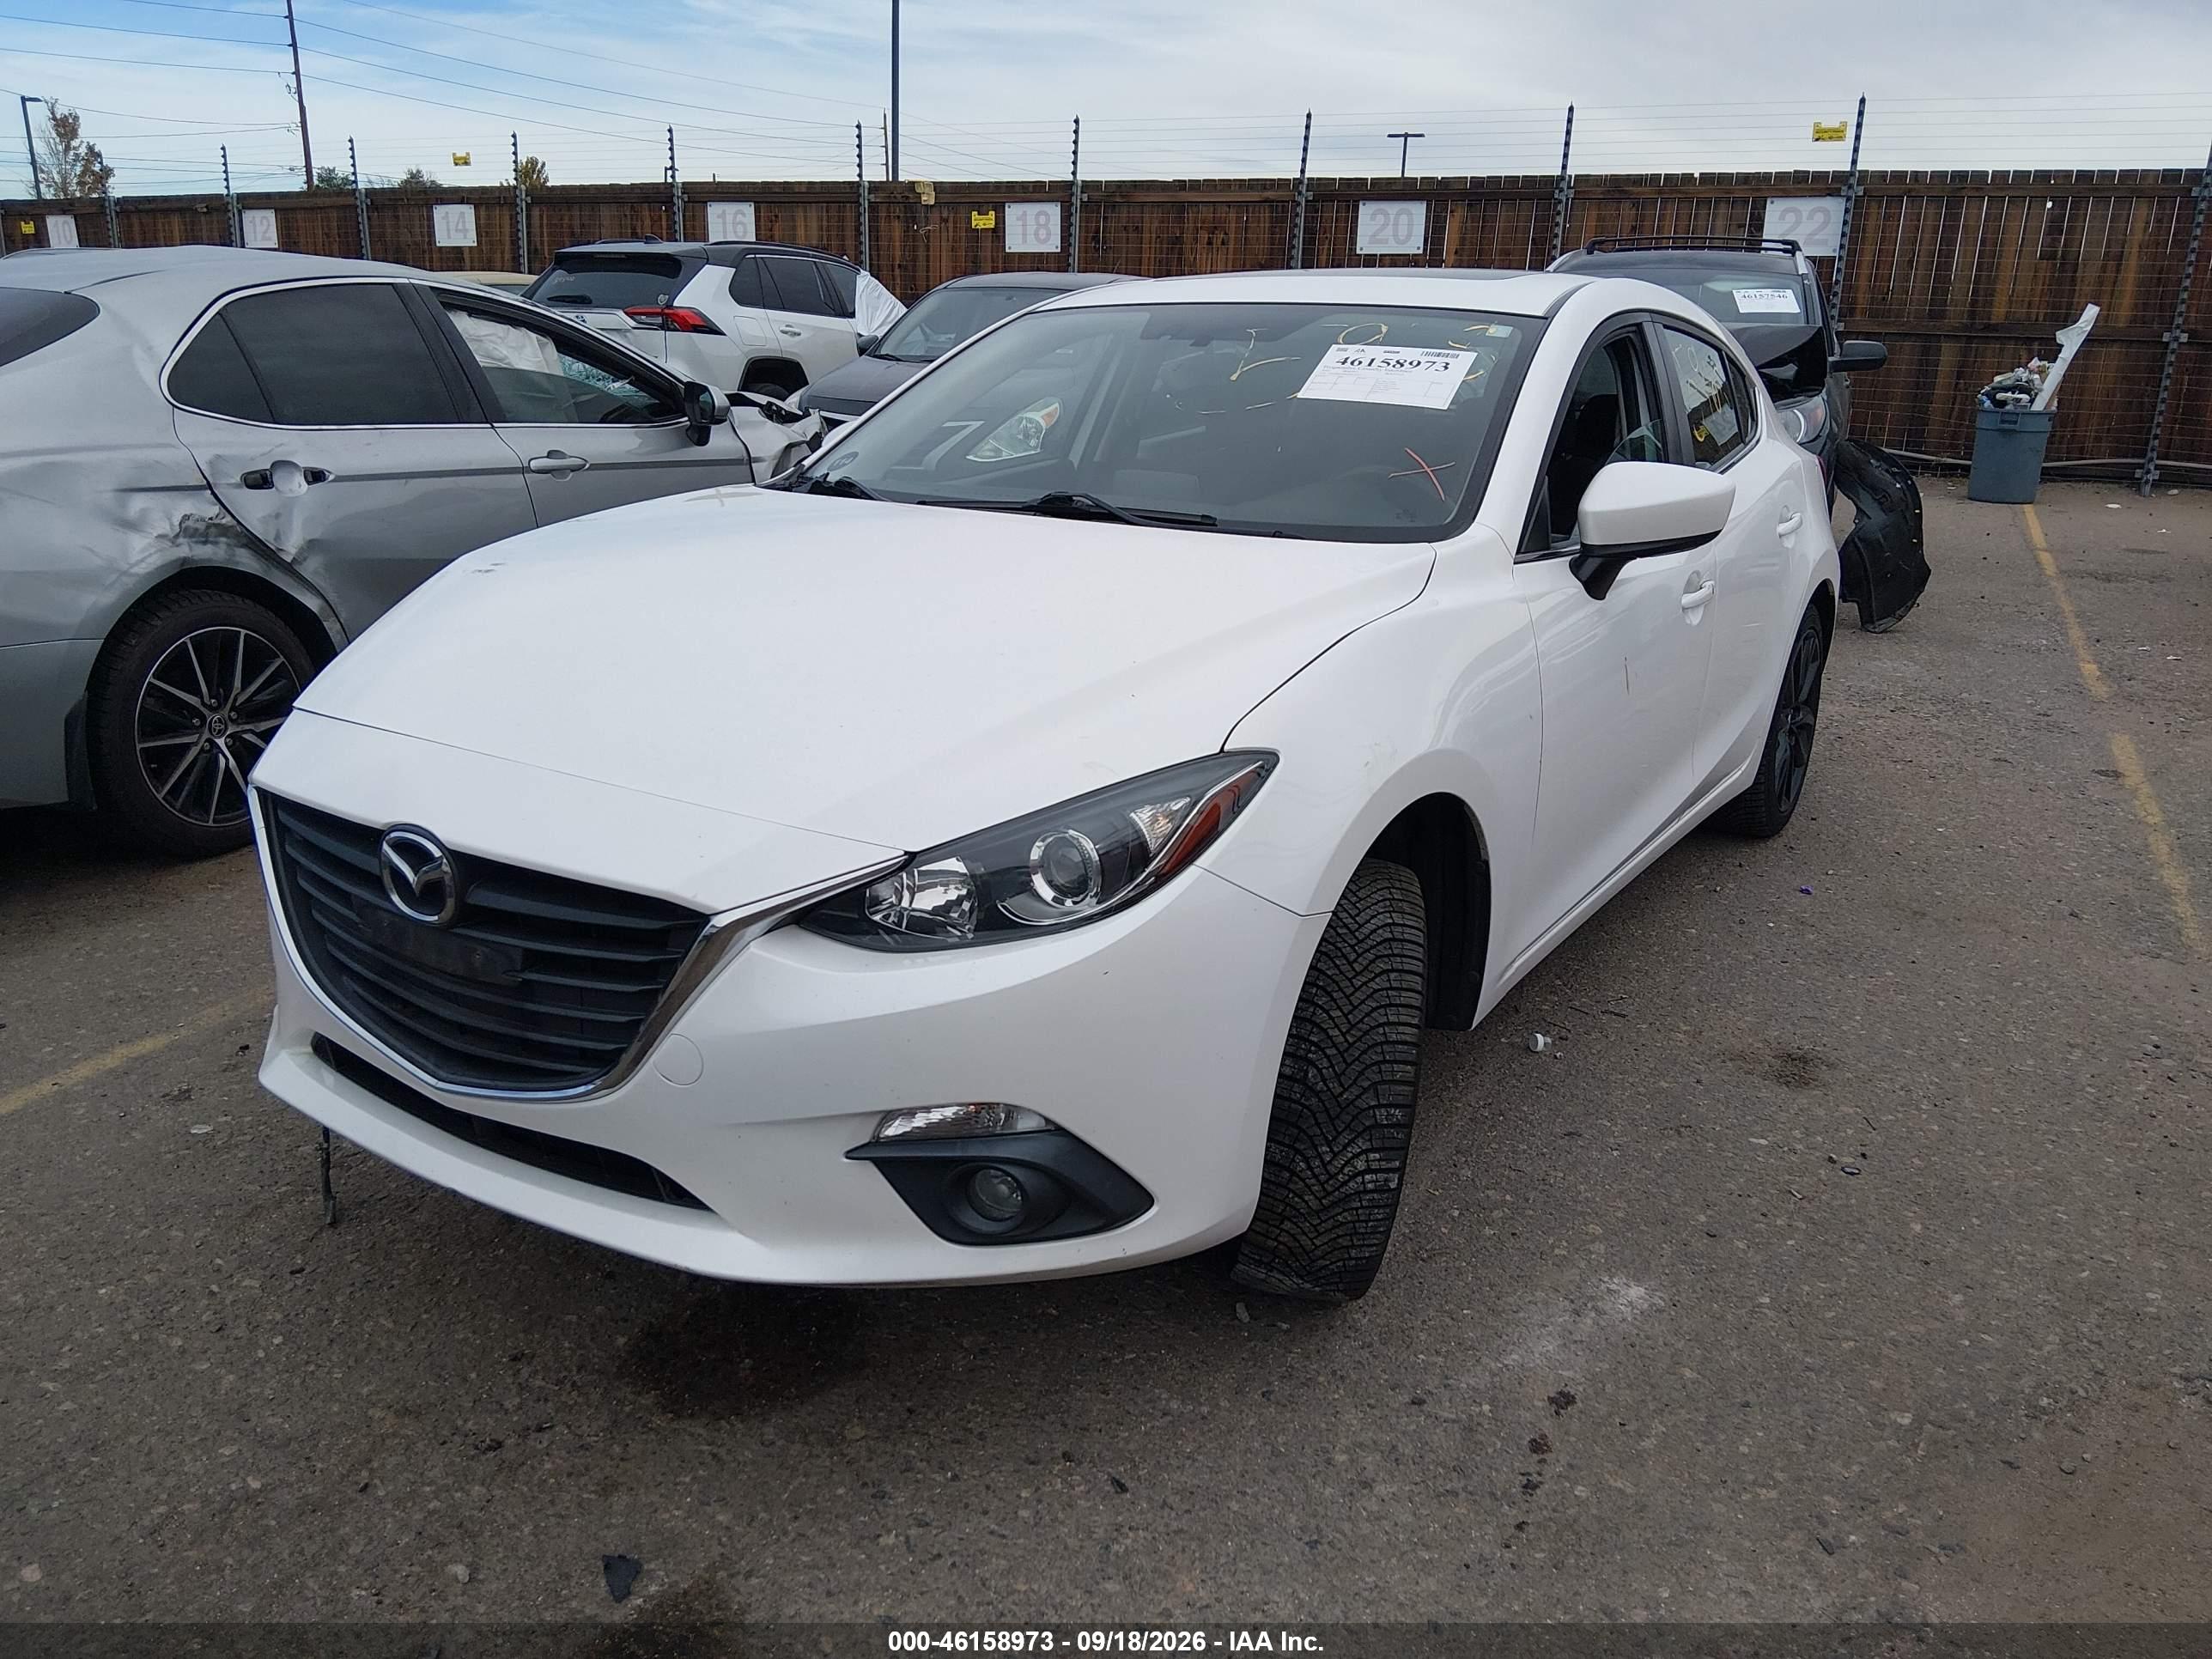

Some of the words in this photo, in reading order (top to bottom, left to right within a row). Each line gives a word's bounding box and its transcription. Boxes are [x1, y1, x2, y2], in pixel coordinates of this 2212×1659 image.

[249, 215, 272, 241] 12
[441, 210, 469, 240] 14
[716, 209, 749, 240] 16
[1016, 210, 1052, 245] 18
[1366, 207, 1414, 246] 20
[1778, 206, 1832, 247] 22
[1335, 356, 1450, 373] 46158973
